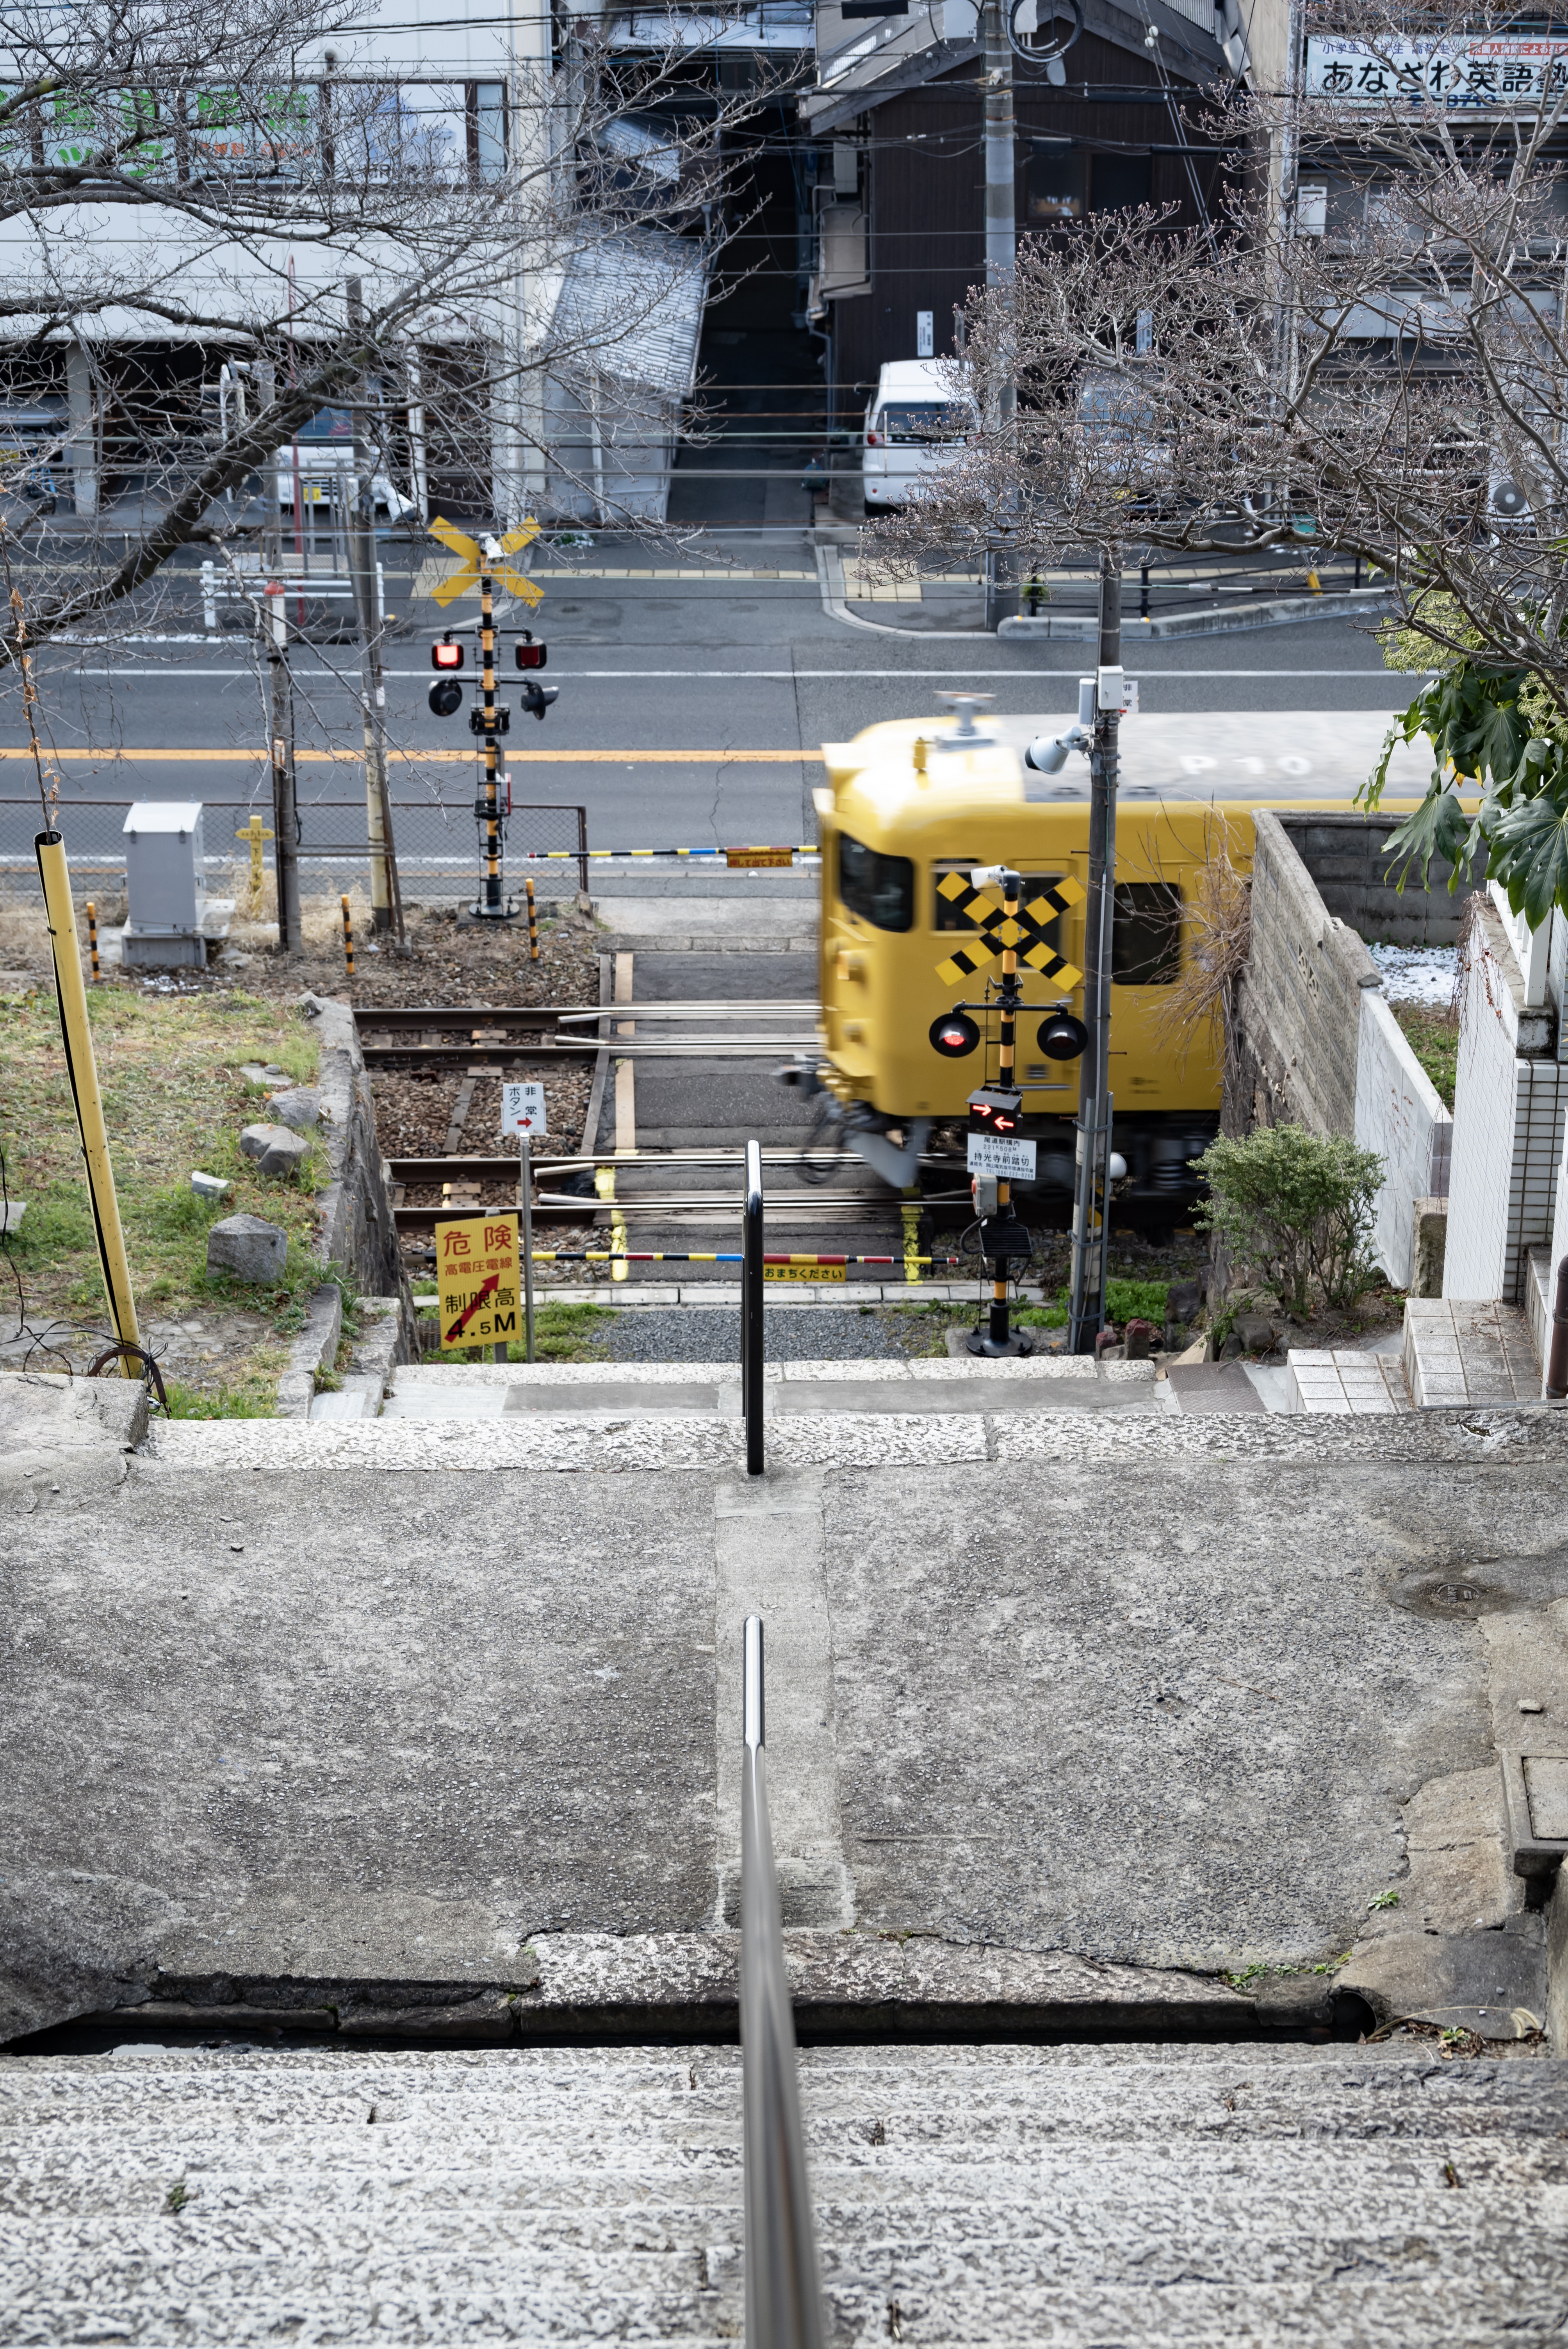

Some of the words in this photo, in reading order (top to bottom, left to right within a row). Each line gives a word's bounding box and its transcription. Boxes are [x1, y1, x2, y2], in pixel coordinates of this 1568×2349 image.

[1322, 42, 1359, 54] 小学生
[509, 1087, 521, 1116] ボタン
[525, 1086, 537, 1116] 非常
[974, 1153, 1029, 1166] 持光寺前踏切
[444, 1224, 512, 1257] 危険
[445, 1256, 513, 1276] 高電圧電線
[764, 1268, 842, 1279] おまちください
[445, 1287, 515, 1314] 制限高
[447, 1311, 516, 1338] 4.5M
